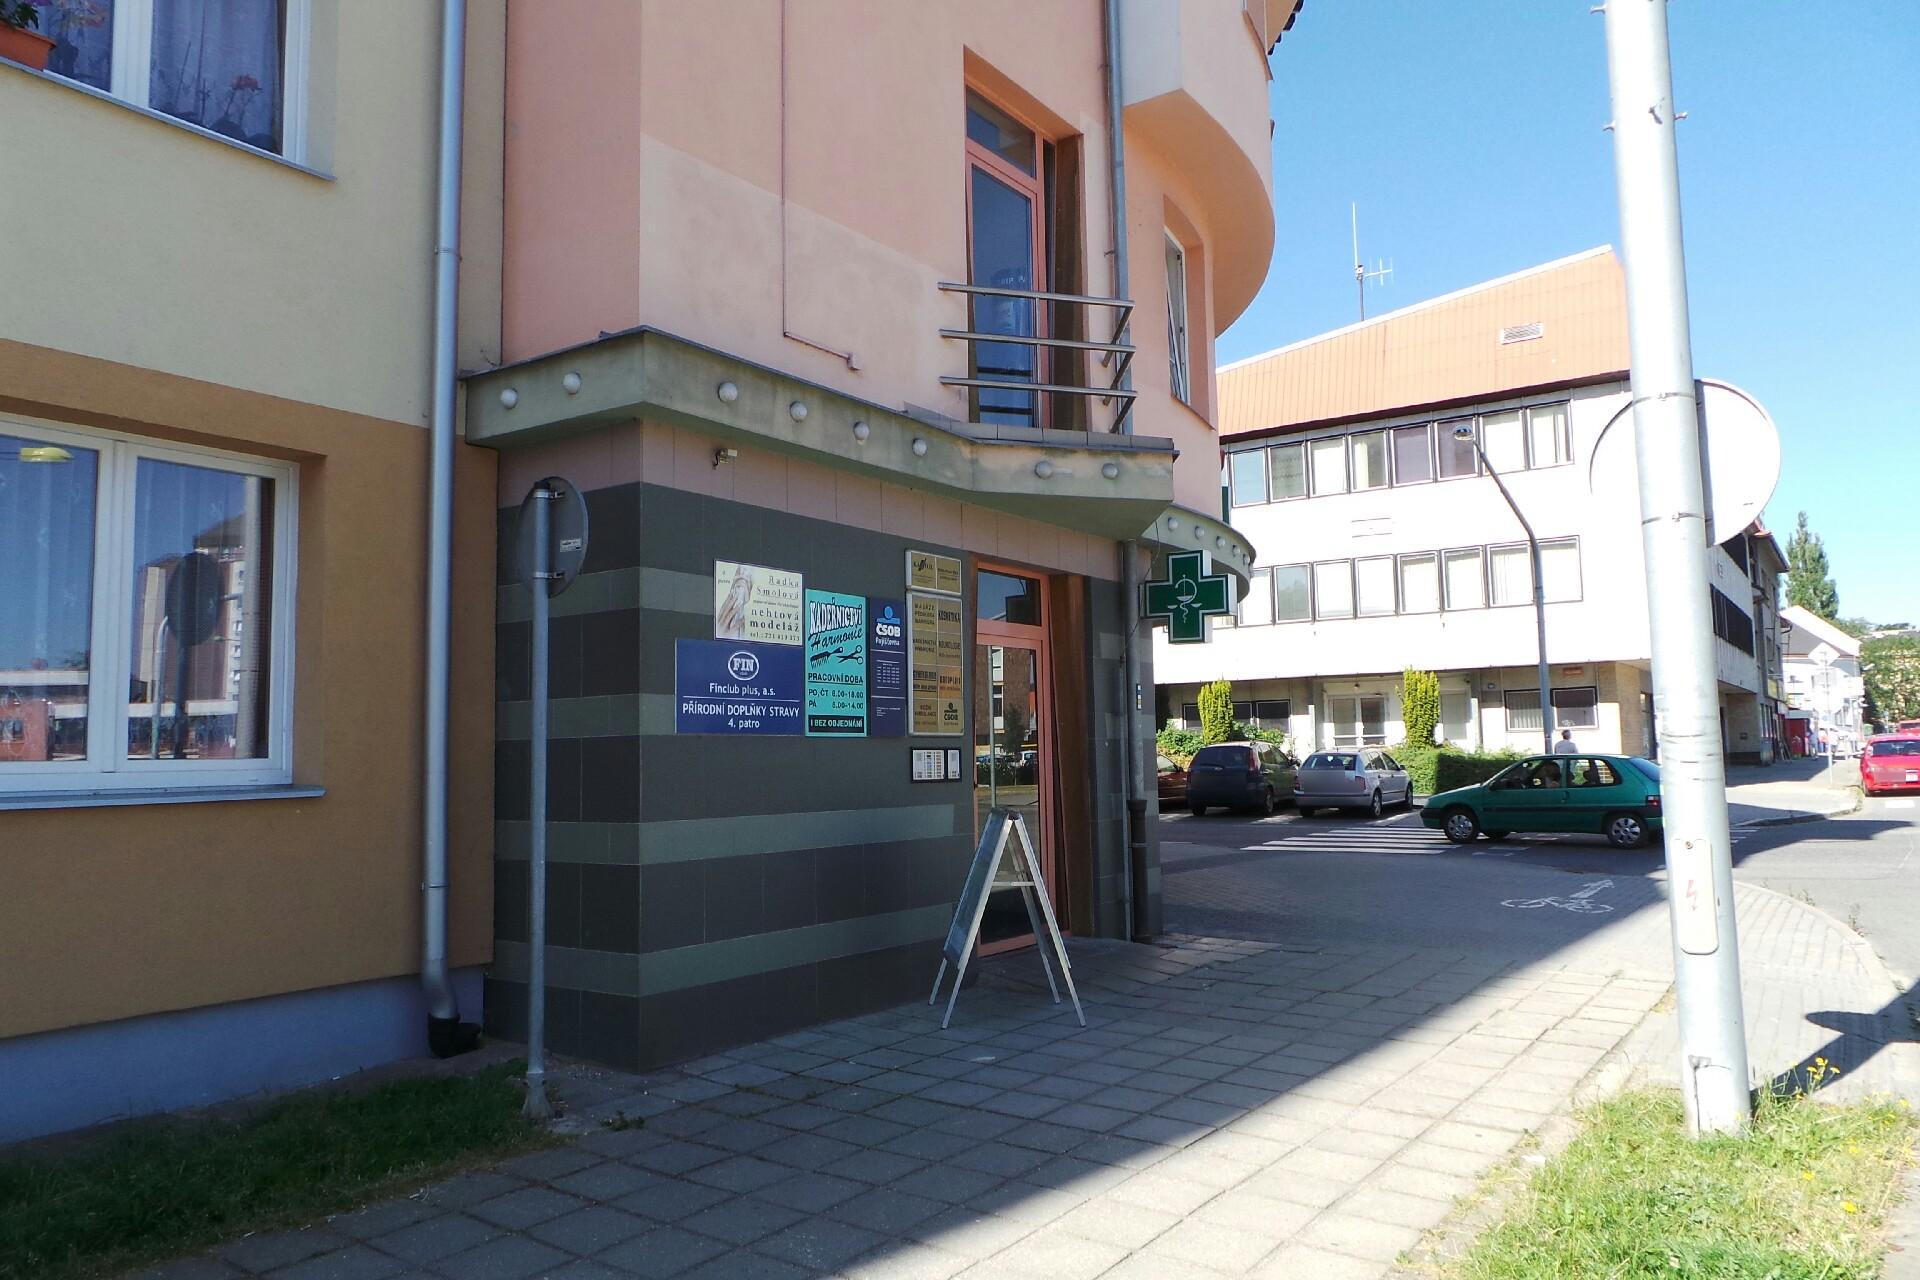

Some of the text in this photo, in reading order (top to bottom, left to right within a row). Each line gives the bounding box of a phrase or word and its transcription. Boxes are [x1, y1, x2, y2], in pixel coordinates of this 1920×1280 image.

[768, 576, 799, 588] Radka
[757, 587, 799, 599] Smolová
[752, 608, 799, 620] nehtová
[808, 597, 862, 634] KADEŘNICTVÍ
[750, 620, 799, 632] modeláž
[876, 622, 900, 638] ČSOB
[808, 628, 863, 651] Harmonie
[732, 658, 754, 672] FIN
[808, 672, 864, 684] PRACOVNÍ DOBA
[710, 682, 776, 696] Finclub plus, a.s.
[682, 700, 800, 717] PŘÍRODNÍ DOPLŇKY STRAVY
[808, 700, 817, 708] PÁ
[728, 718, 760, 730] 4. patro
[828, 718, 863, 728] OBJEDNÁNÍ
